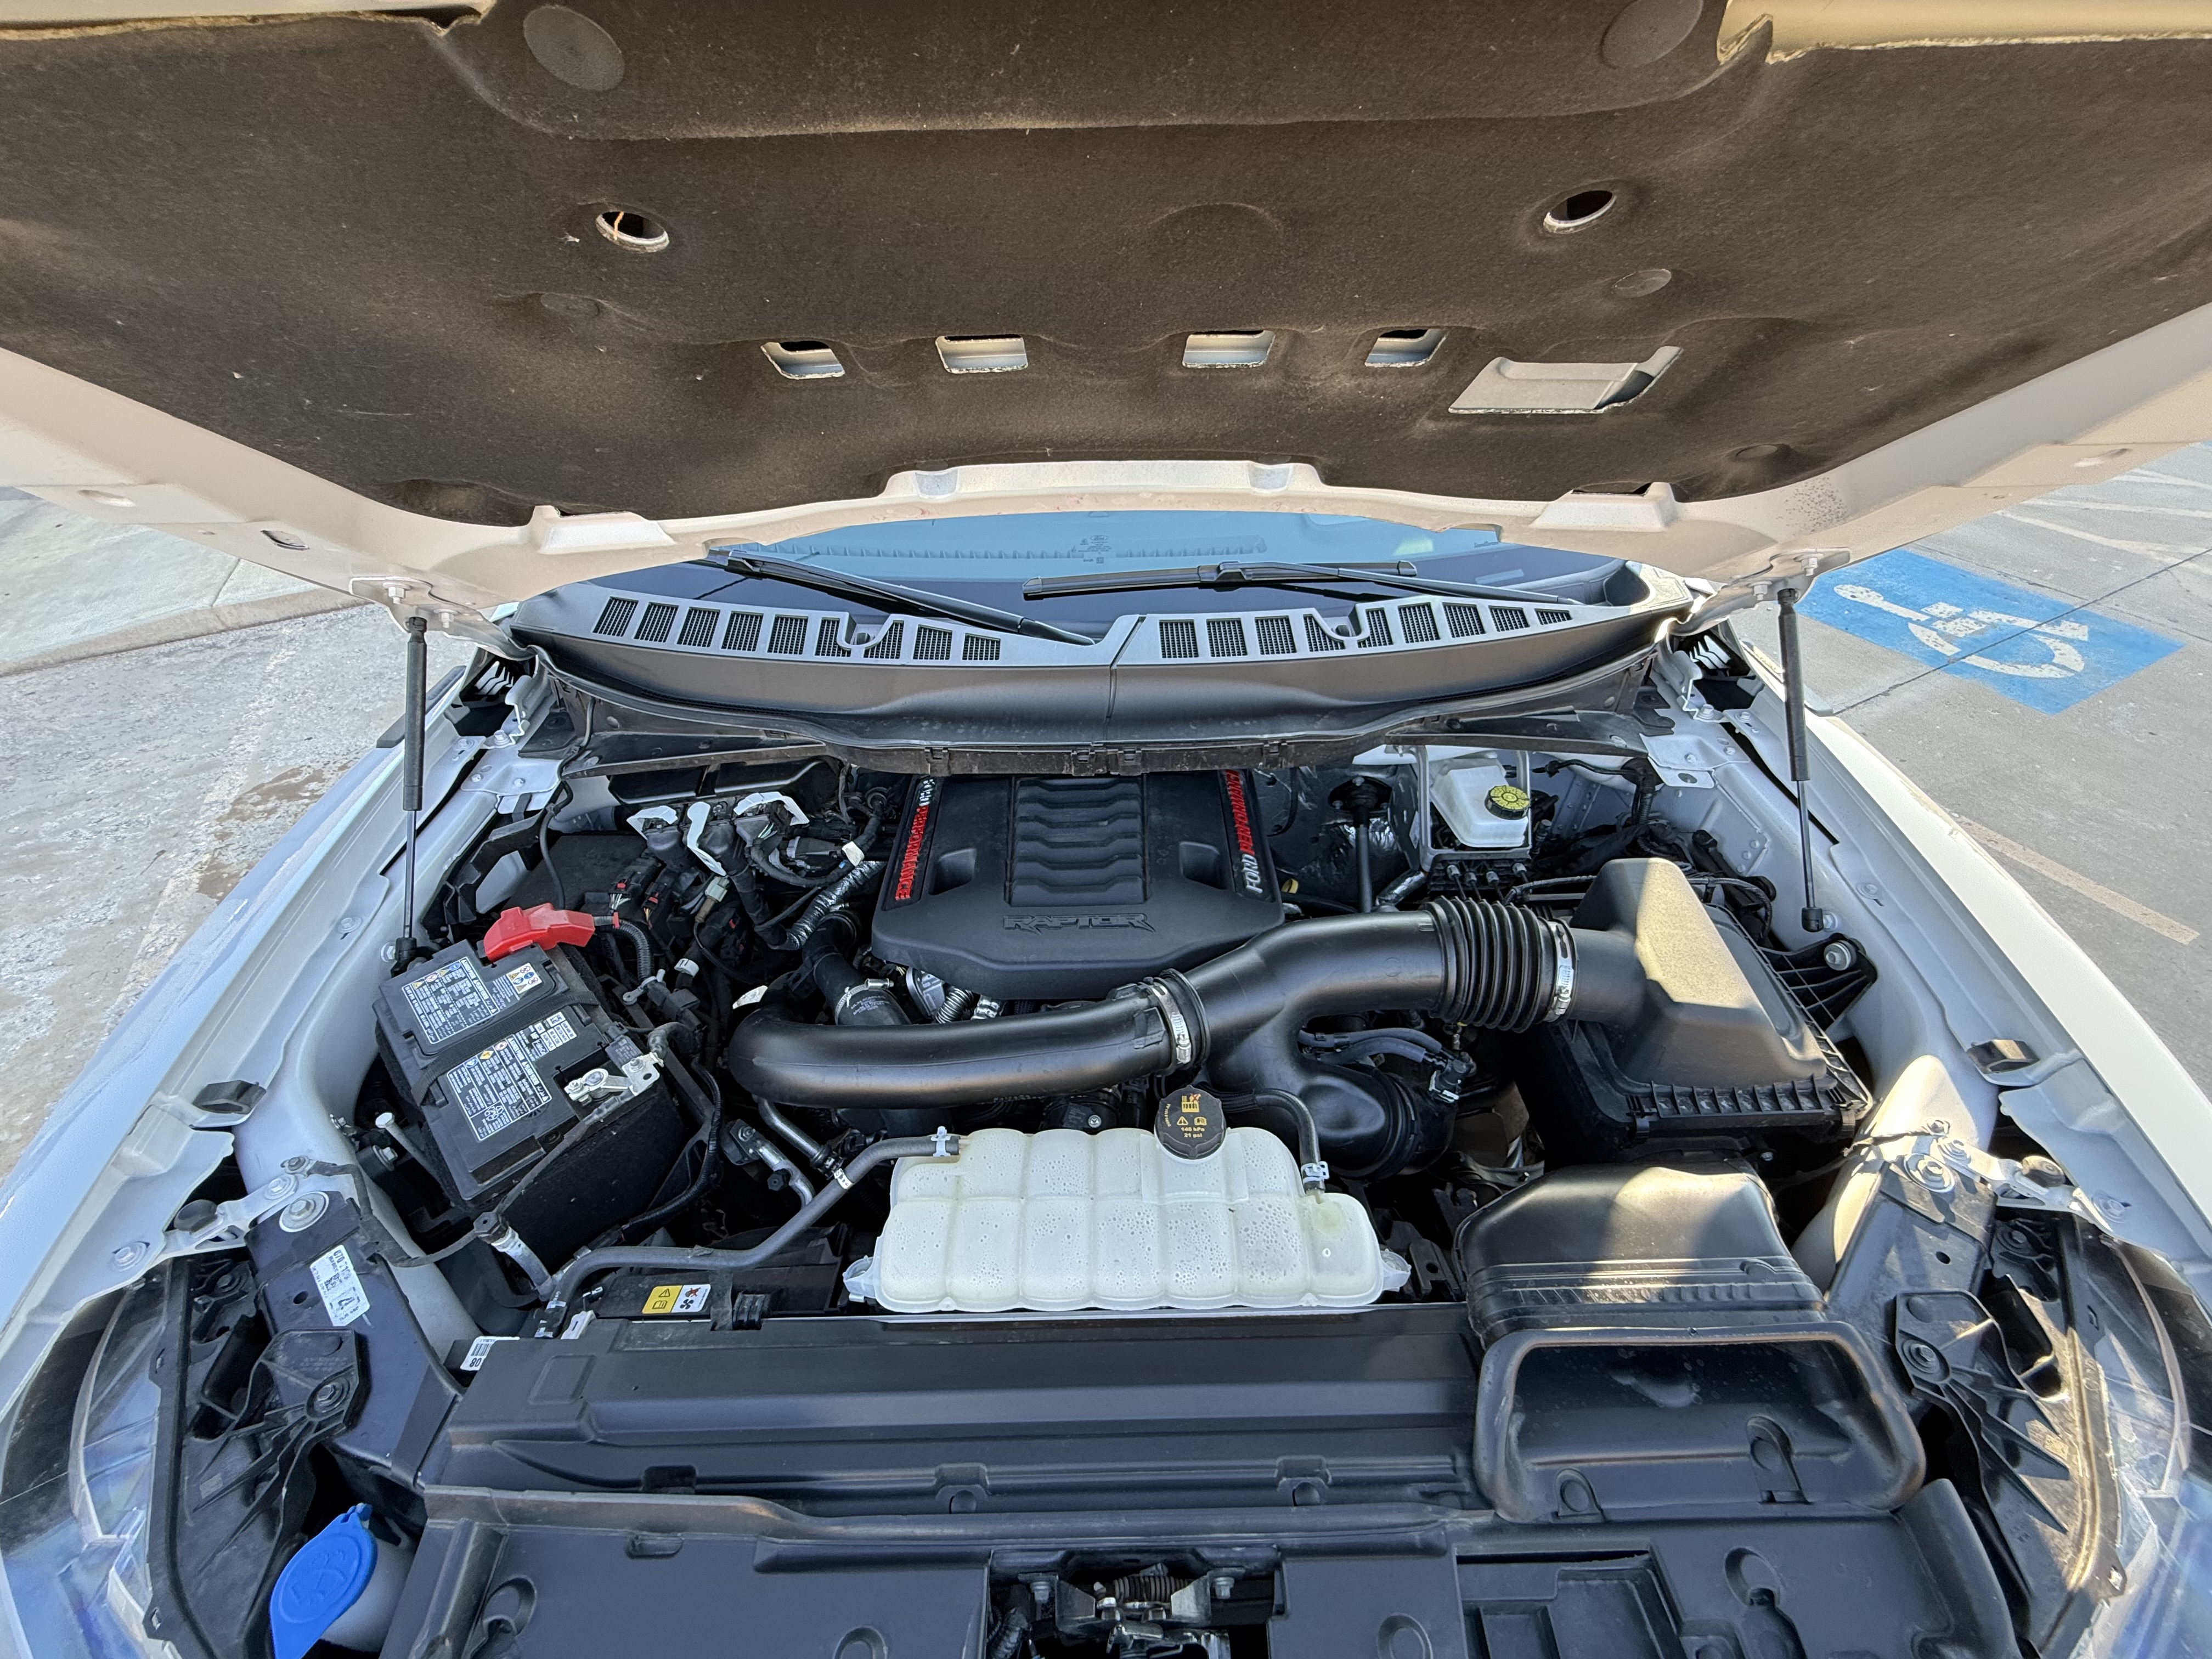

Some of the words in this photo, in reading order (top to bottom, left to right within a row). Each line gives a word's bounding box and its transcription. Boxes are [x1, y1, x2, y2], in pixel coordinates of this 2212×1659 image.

[895, 805, 929, 900] PERFORMANCE
[1242, 853, 1263, 894] FORD
[1003, 912, 1156, 935] RAPTOR
